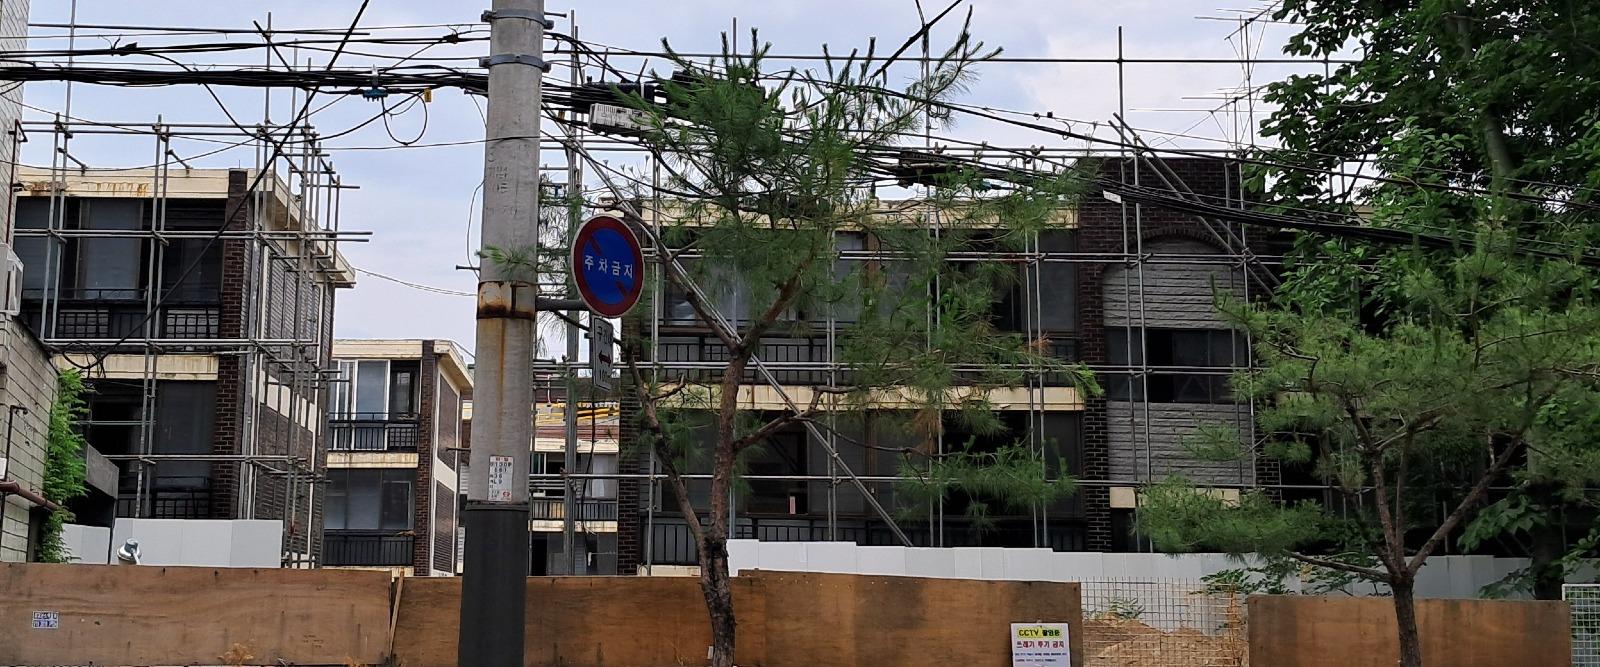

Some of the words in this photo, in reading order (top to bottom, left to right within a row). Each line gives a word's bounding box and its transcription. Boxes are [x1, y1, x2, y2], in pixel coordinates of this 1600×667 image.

[584, 254, 633, 279] 주차금지
[1018, 629, 1039, 637] CCTV
[1016, 641, 1035, 649] 쓰레기
